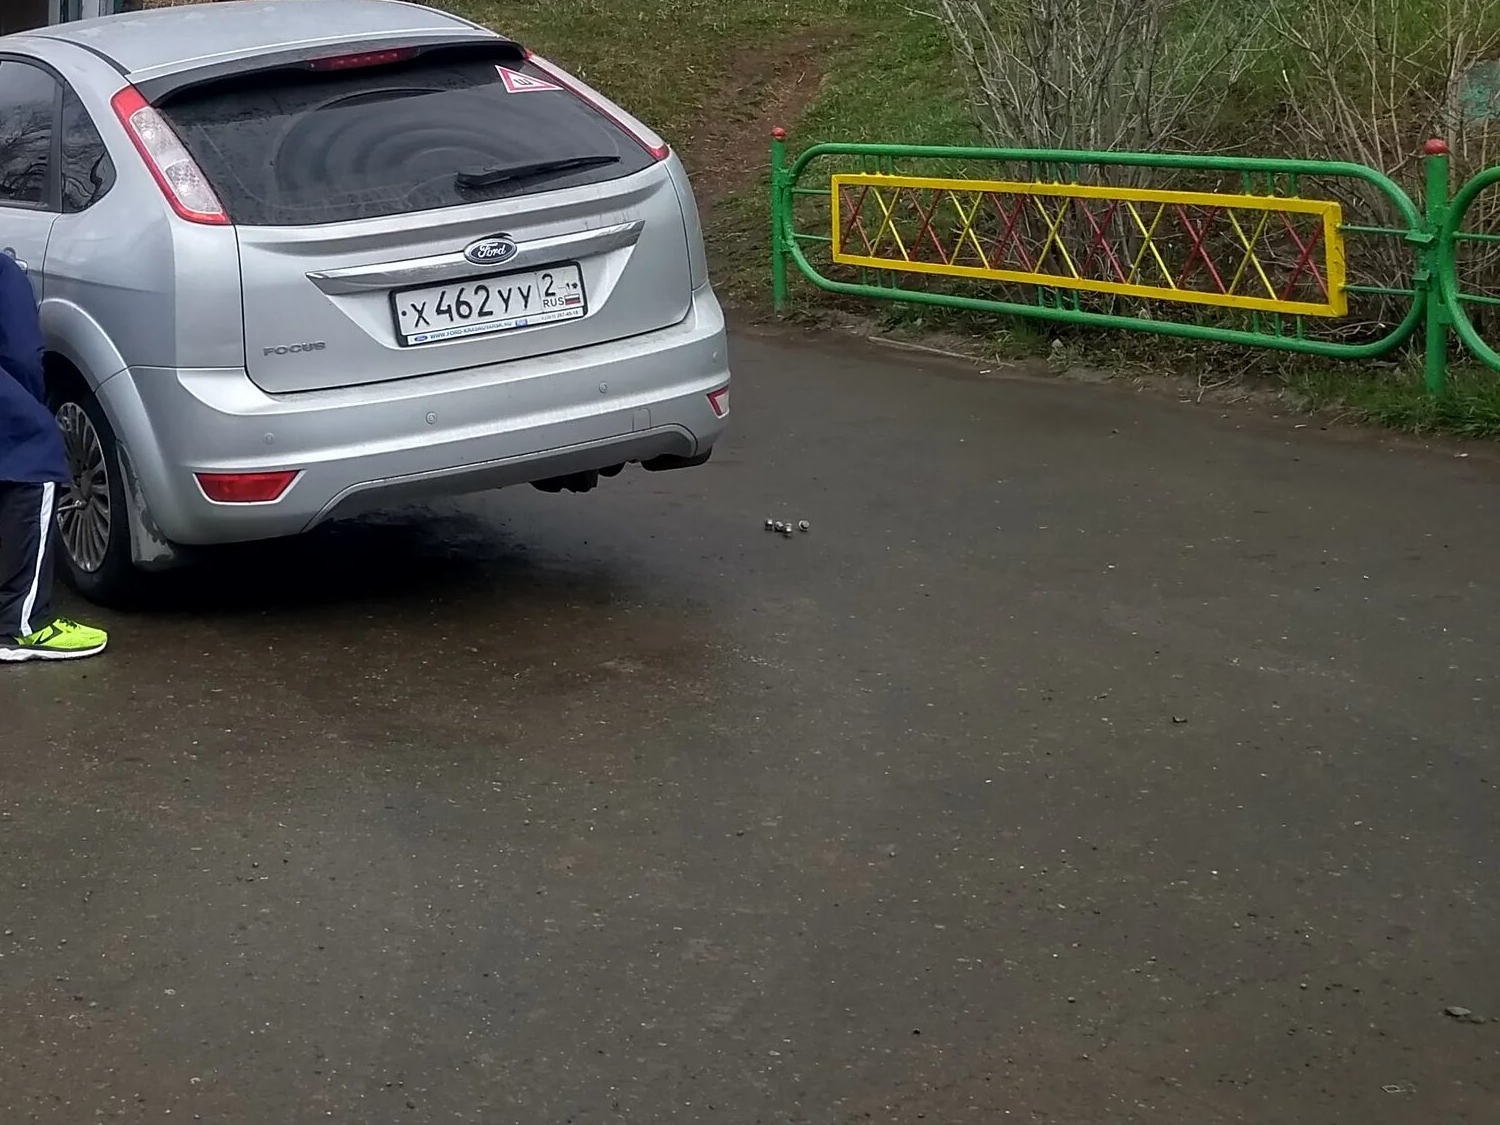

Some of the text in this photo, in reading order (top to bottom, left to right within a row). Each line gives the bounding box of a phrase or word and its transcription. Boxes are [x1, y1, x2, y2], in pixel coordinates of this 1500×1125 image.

[512, 78, 534, 86] Ш
[477, 242, 507, 259] Ford
[542, 296, 565, 309] RUS
[263, 340, 326, 357] FOCUS
